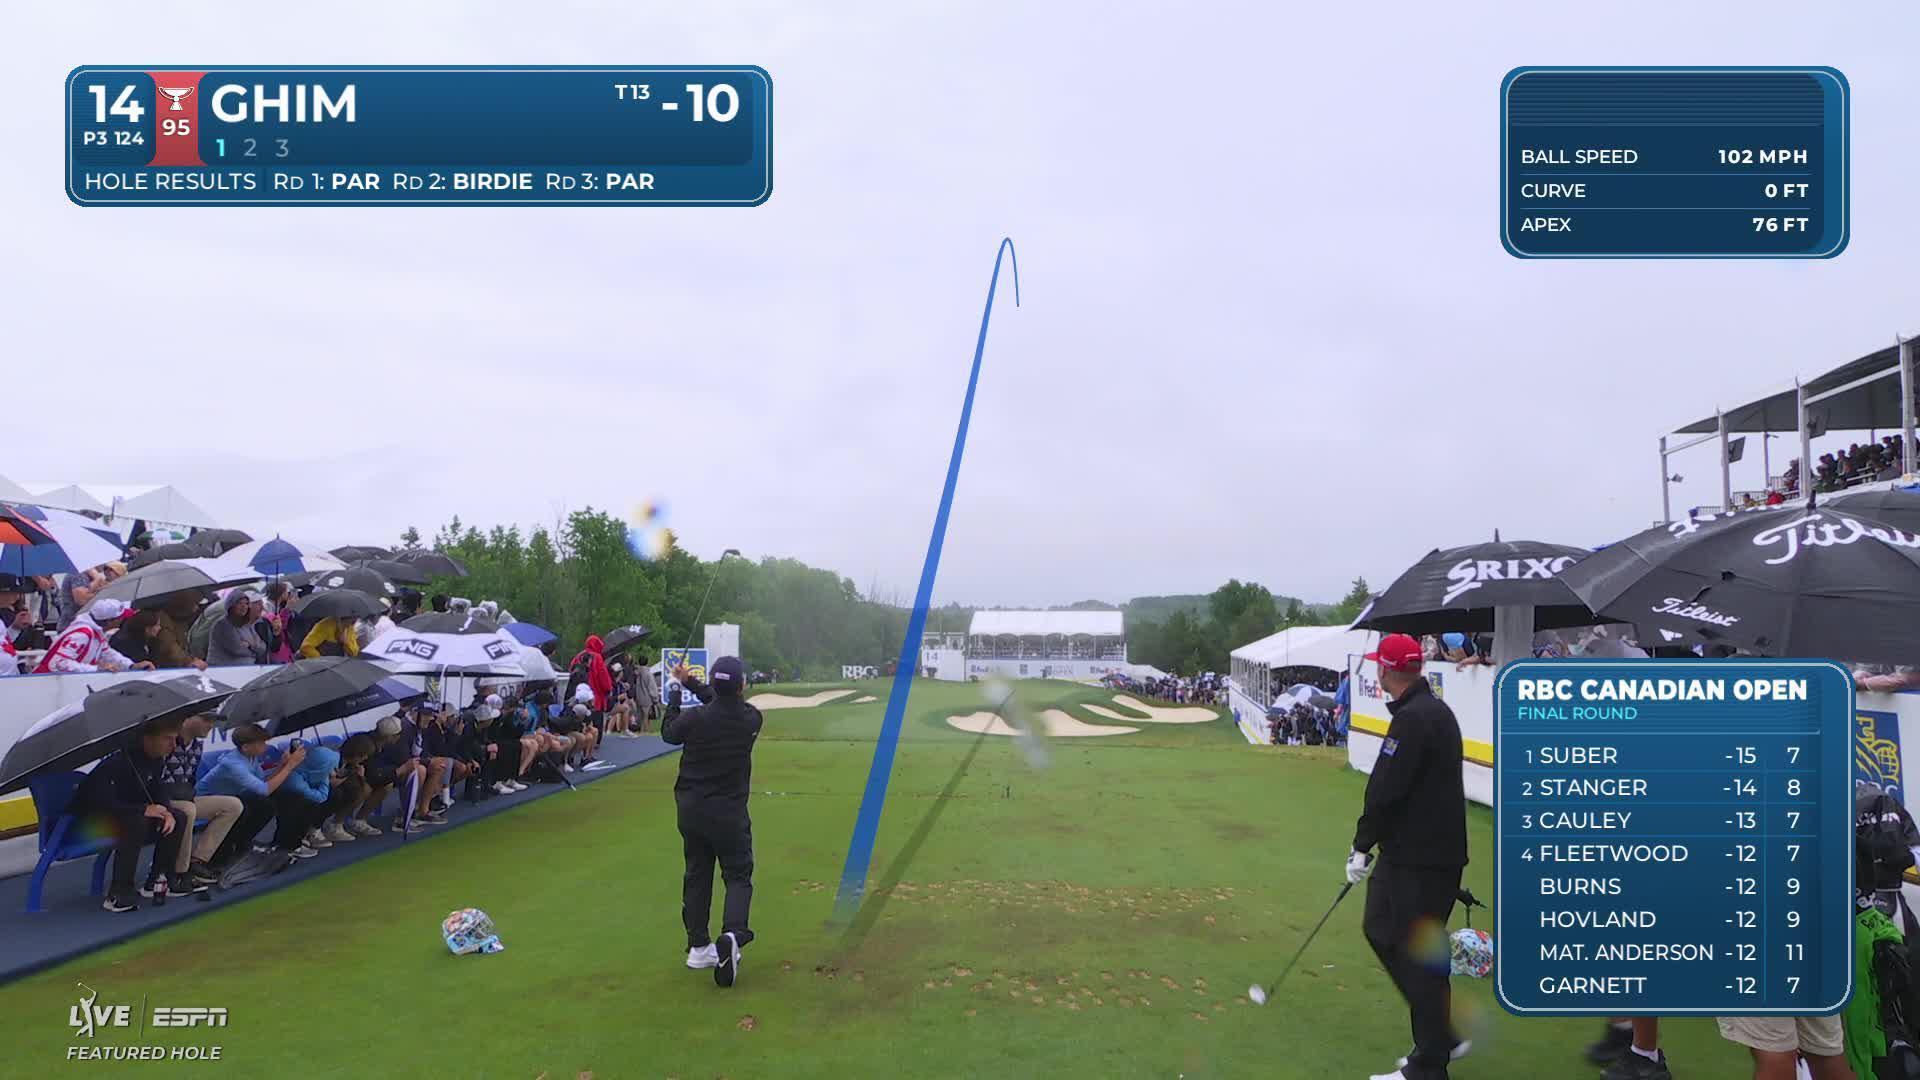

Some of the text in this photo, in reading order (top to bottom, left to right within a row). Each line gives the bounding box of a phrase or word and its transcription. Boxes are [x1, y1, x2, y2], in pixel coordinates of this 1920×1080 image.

[1441, 556, 1577, 607] SRIXO
[1651, 597, 1738, 627] Titleist
[387, 641, 434, 656] PING
[841, 664, 874, 679] RBC
